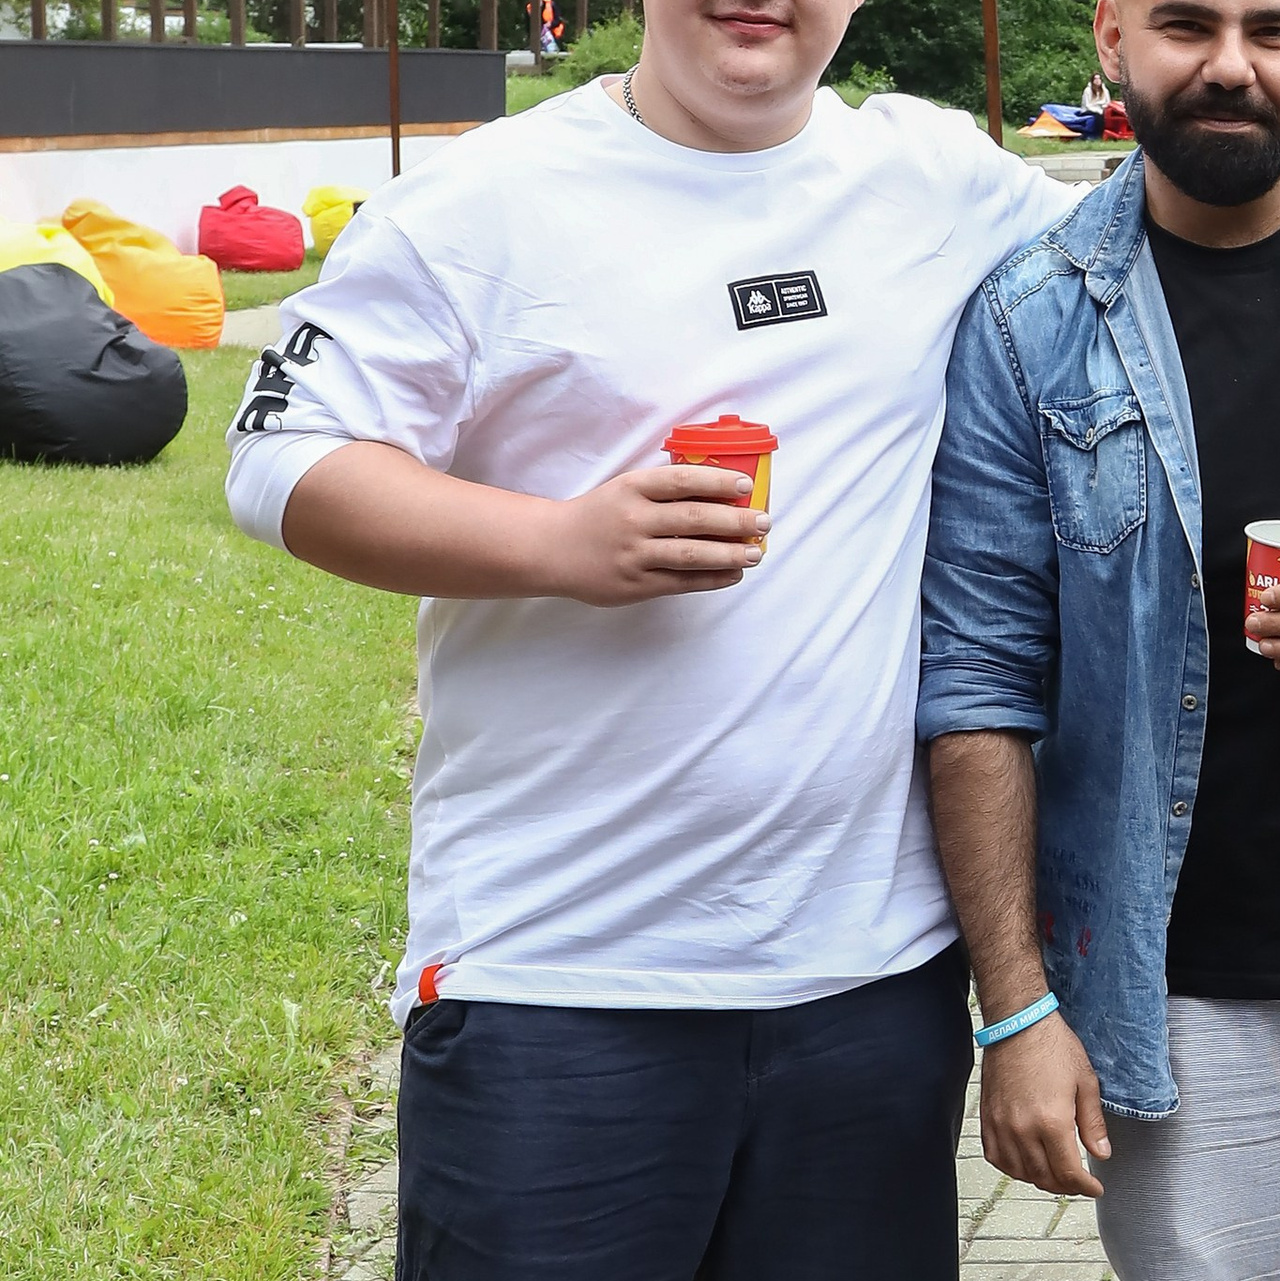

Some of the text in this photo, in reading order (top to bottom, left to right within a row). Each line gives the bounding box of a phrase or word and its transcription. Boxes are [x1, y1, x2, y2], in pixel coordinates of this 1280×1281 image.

[749, 302, 772, 314] Kappa
[988, 1019, 1019, 1041] ДЕЛАЙ
[1019, 1007, 1040, 1026] МИР
